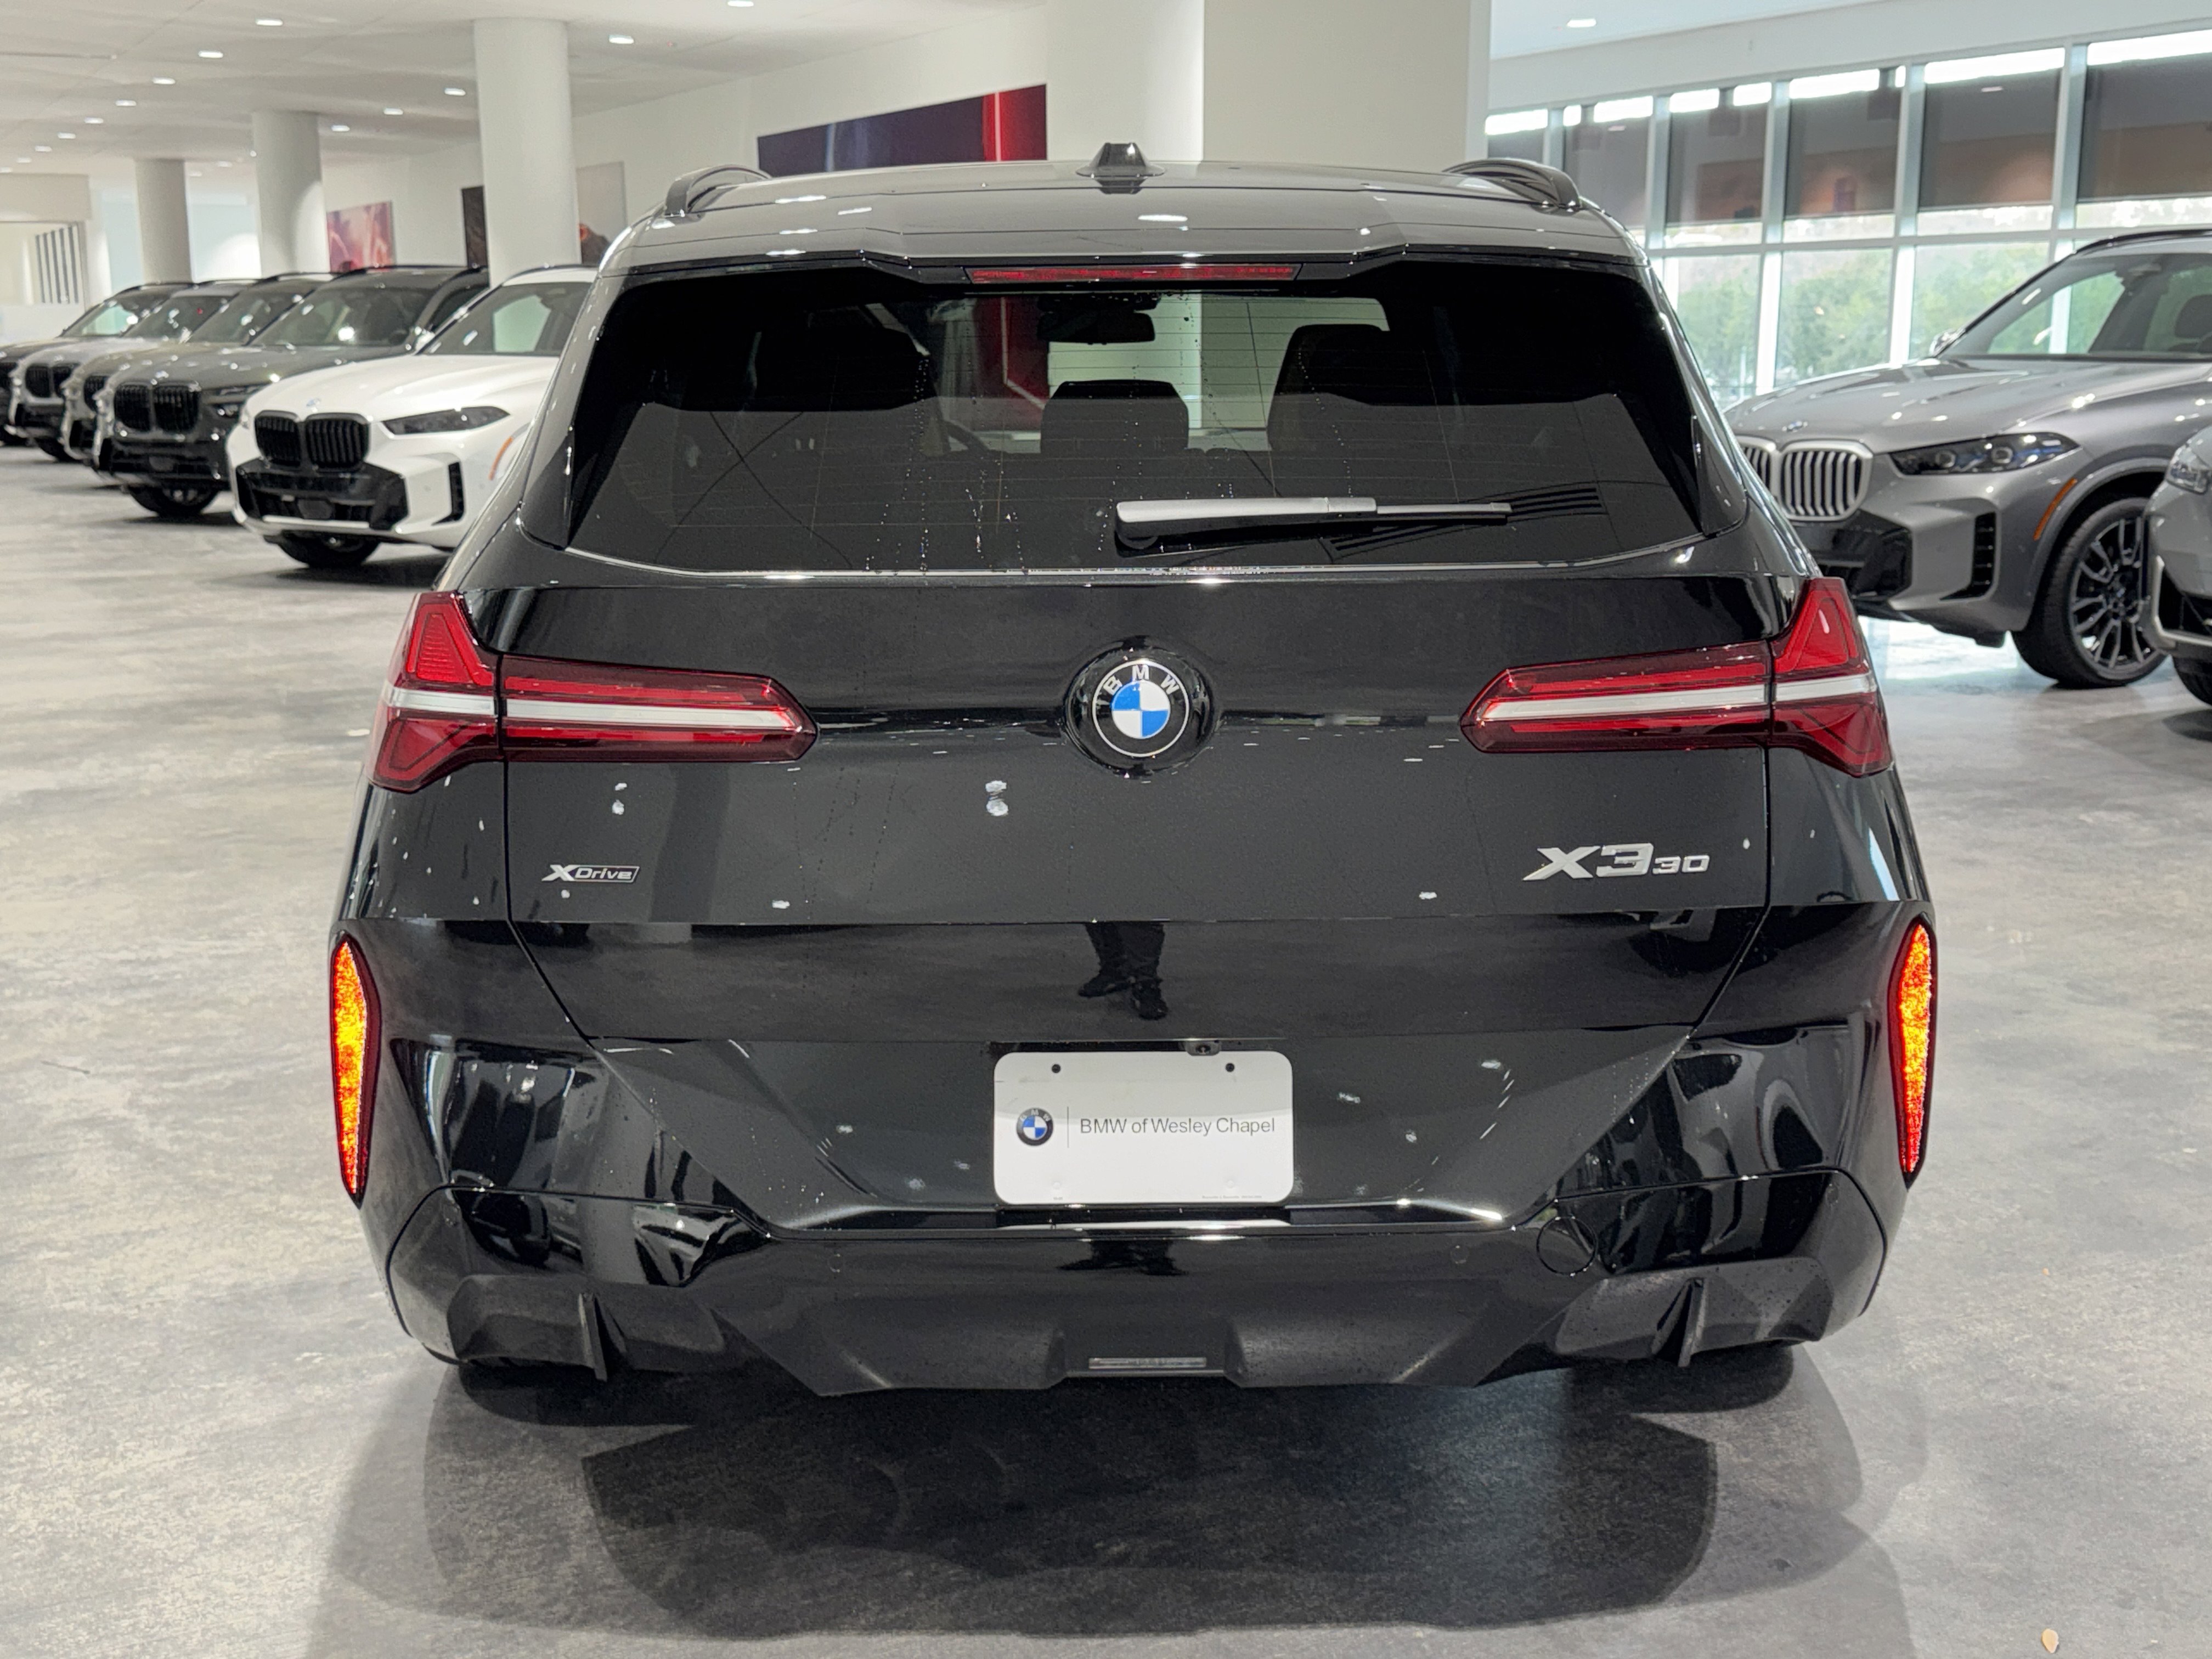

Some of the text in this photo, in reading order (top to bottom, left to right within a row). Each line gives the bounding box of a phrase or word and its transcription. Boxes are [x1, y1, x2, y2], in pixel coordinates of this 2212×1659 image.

[1103, 664, 1180, 696] BMW
[1080, 1117, 1274, 1137] BMW of Wesley Chapel
